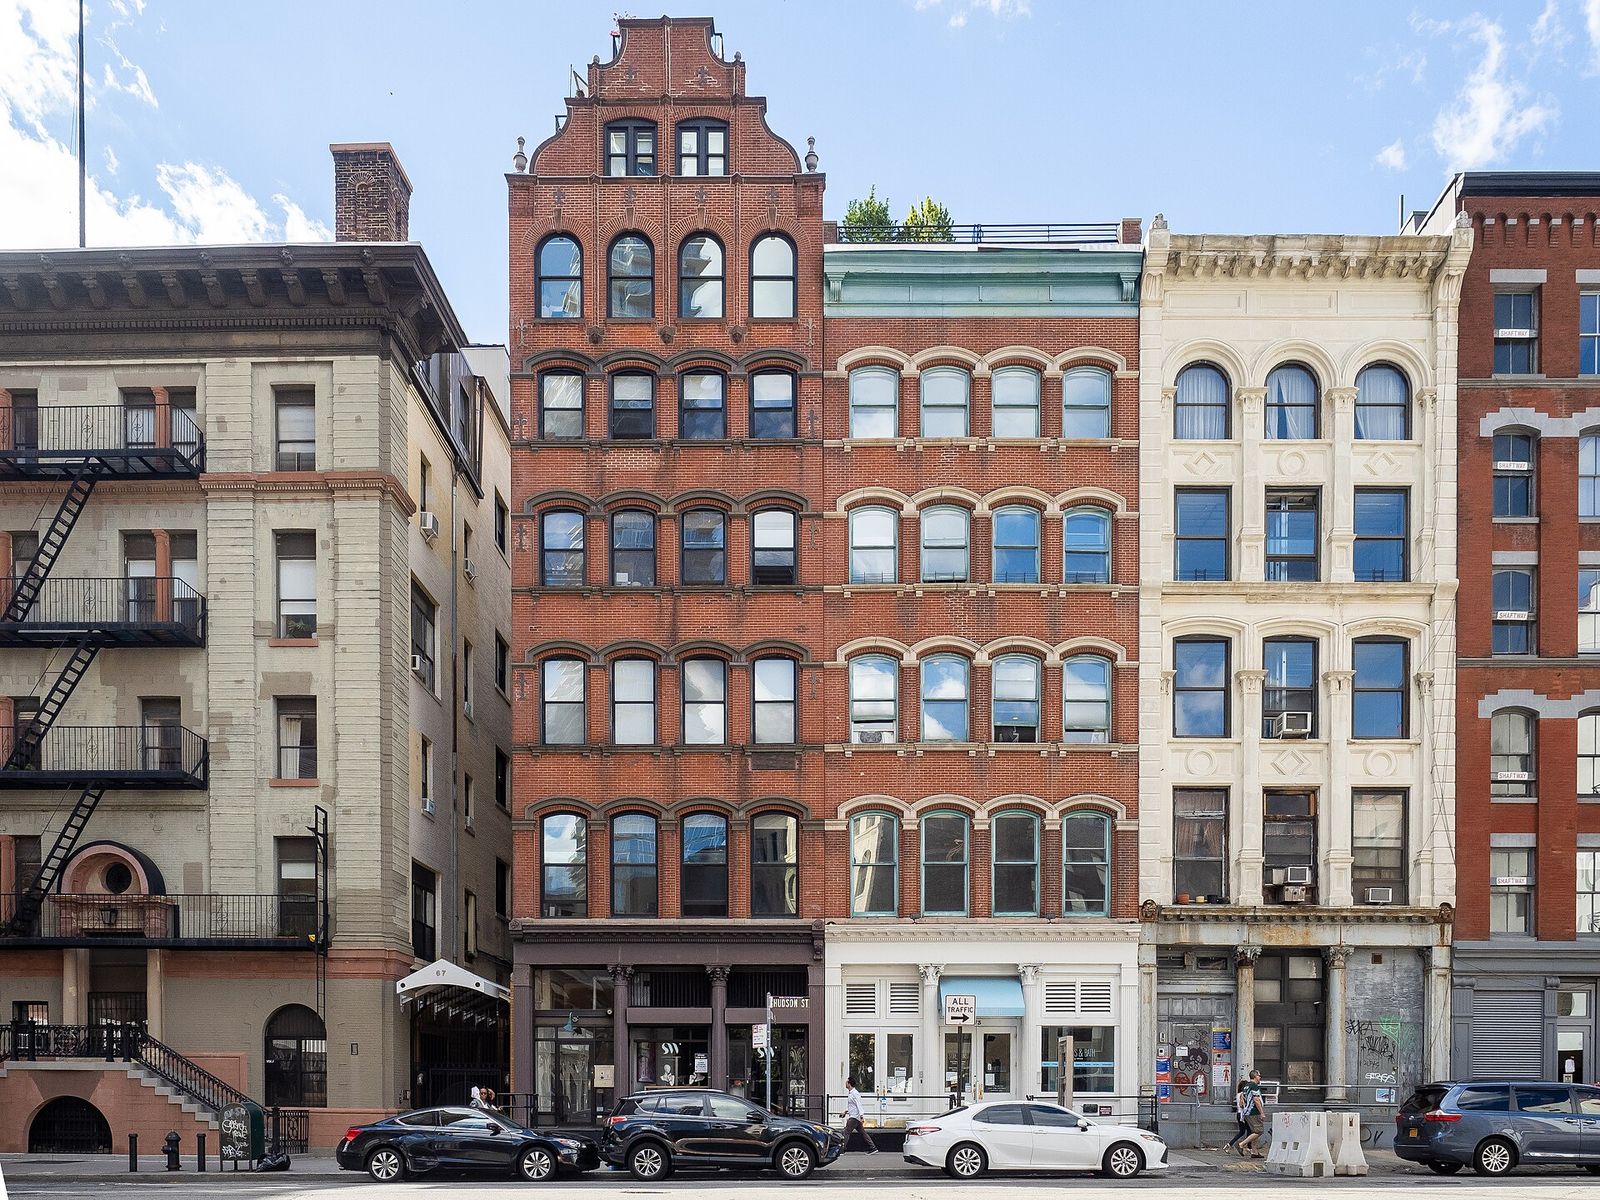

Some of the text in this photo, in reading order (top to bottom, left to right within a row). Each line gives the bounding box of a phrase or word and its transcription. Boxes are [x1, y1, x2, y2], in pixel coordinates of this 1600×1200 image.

[435, 969, 446, 977] 67
[773, 999, 810, 1008] HUDSON ST
[952, 997, 969, 1006] ALL
